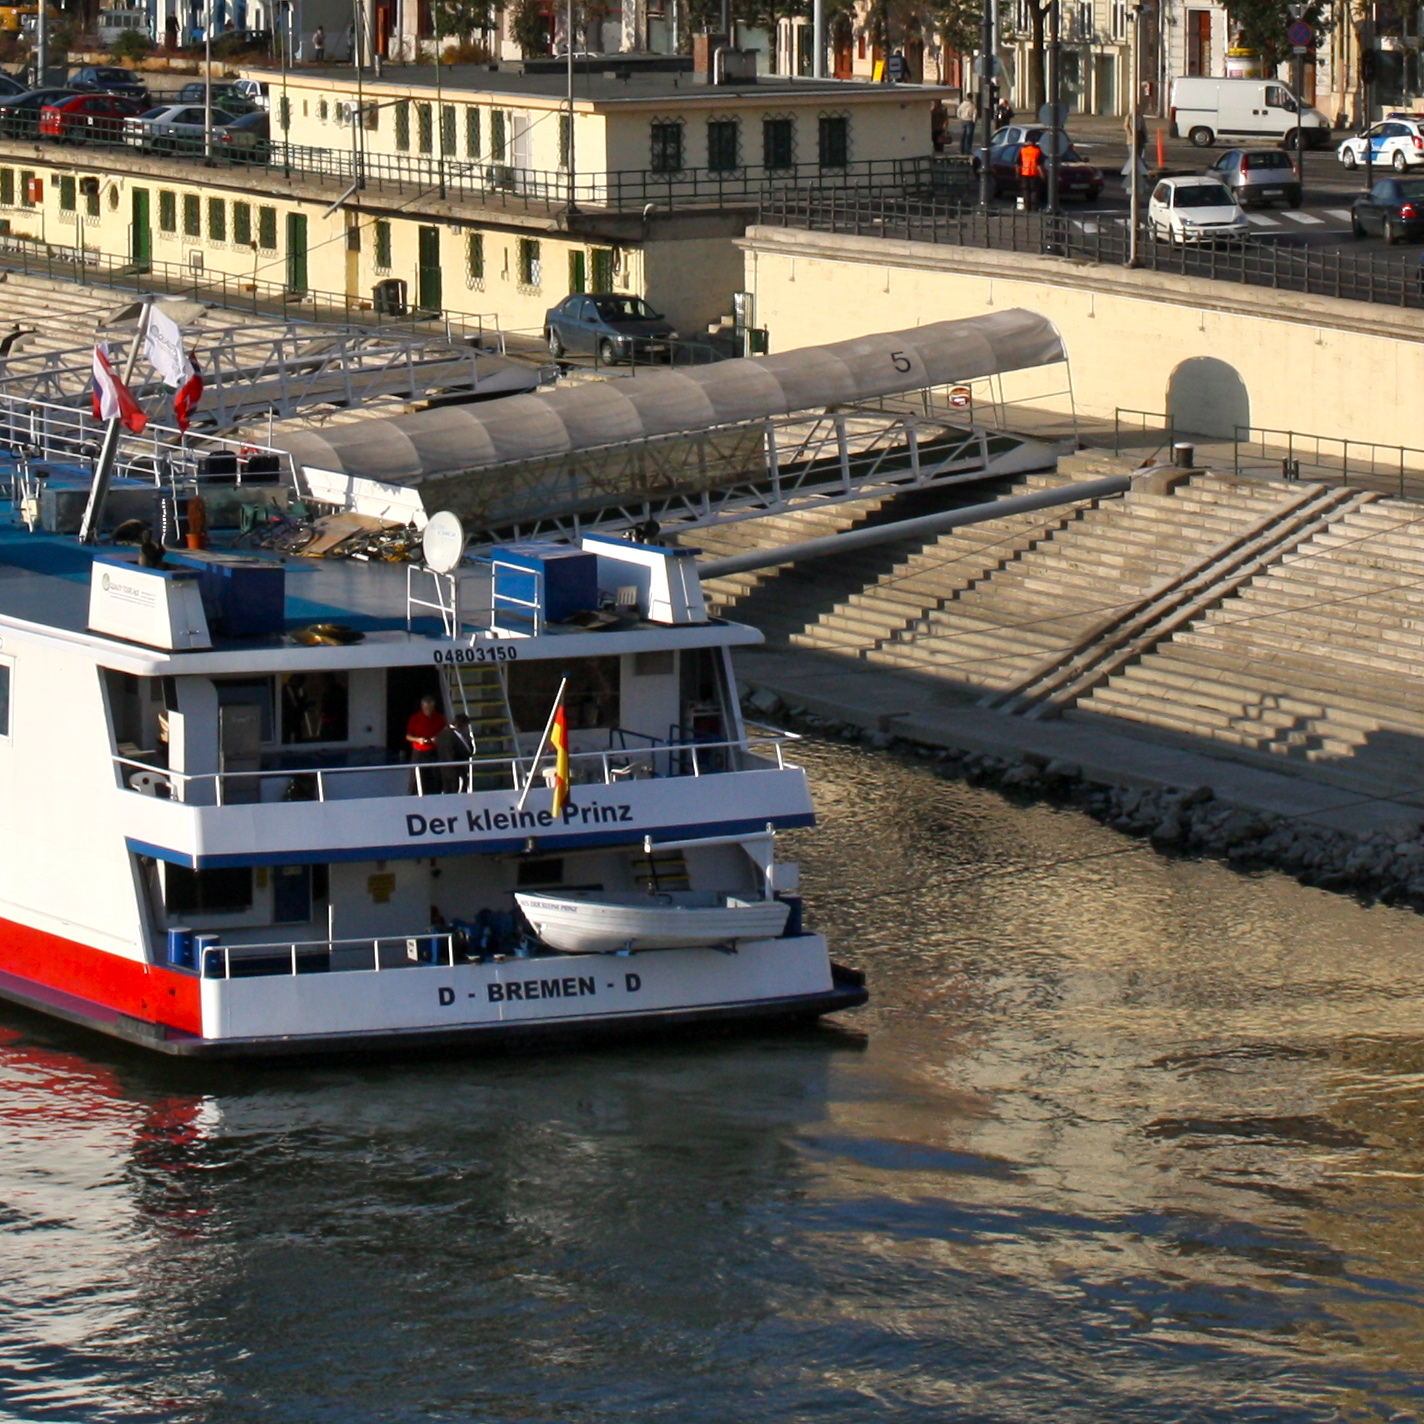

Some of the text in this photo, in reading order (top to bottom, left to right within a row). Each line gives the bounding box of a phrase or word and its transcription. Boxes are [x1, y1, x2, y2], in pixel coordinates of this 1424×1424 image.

[890, 351, 911, 373] 5
[433, 645, 518, 664] 04803150
[405, 801, 634, 837] Der kleine Prinz
[438, 987, 456, 1007] D
[487, 976, 597, 1003] BREMEN
[625, 973, 642, 993] D
